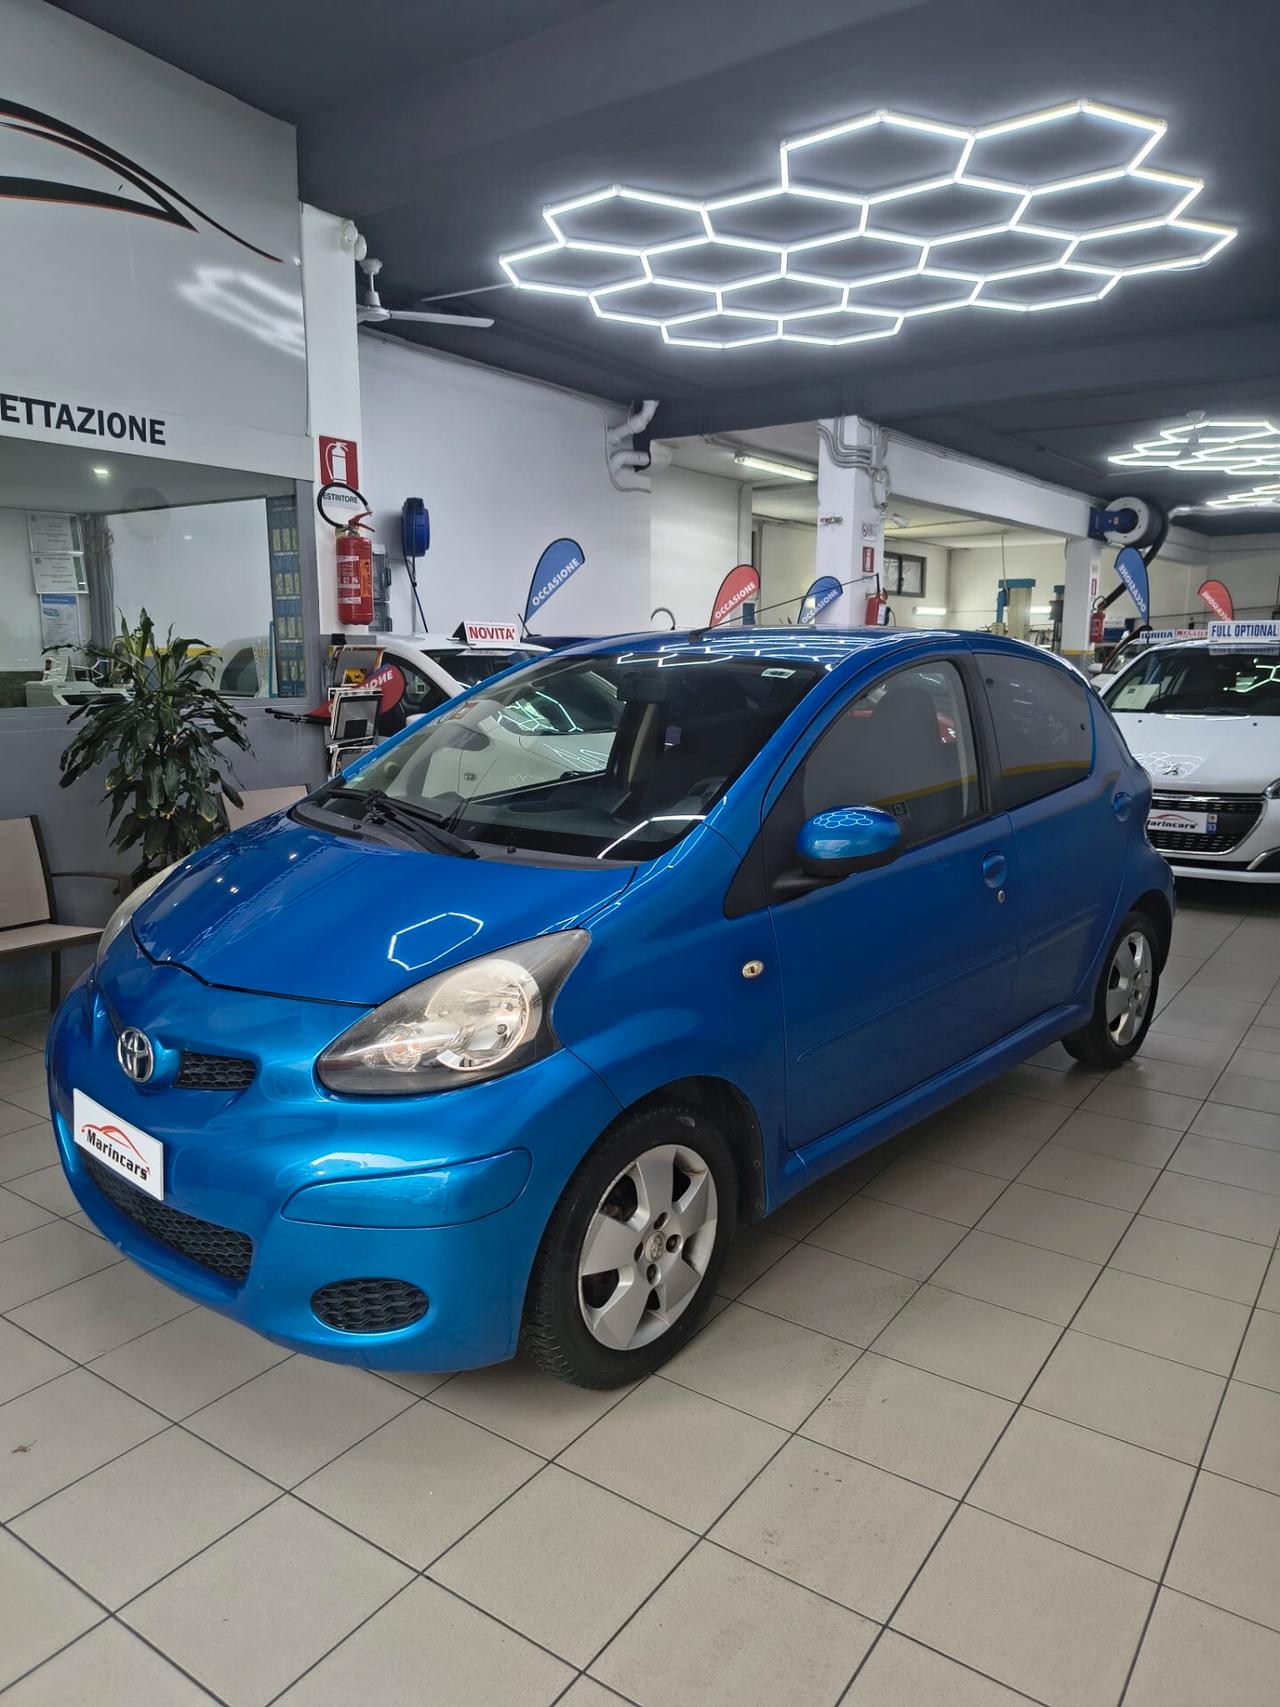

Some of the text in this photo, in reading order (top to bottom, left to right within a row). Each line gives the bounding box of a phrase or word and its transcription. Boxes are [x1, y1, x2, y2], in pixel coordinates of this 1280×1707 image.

[0, 393, 166, 446] ETTAZIONE
[323, 492, 358, 504] ESTINTORE
[532, 558, 580, 606] OCCASIONE
[715, 583, 756, 620] OCCASIONE
[801, 589, 839, 624] OCCASIONE
[468, 626, 515, 640] NOVITA'
[1211, 625, 1231, 637] FULL
[1234, 624, 1277, 637] OPTIONAL
[86, 1129, 148, 1181] Marincars
